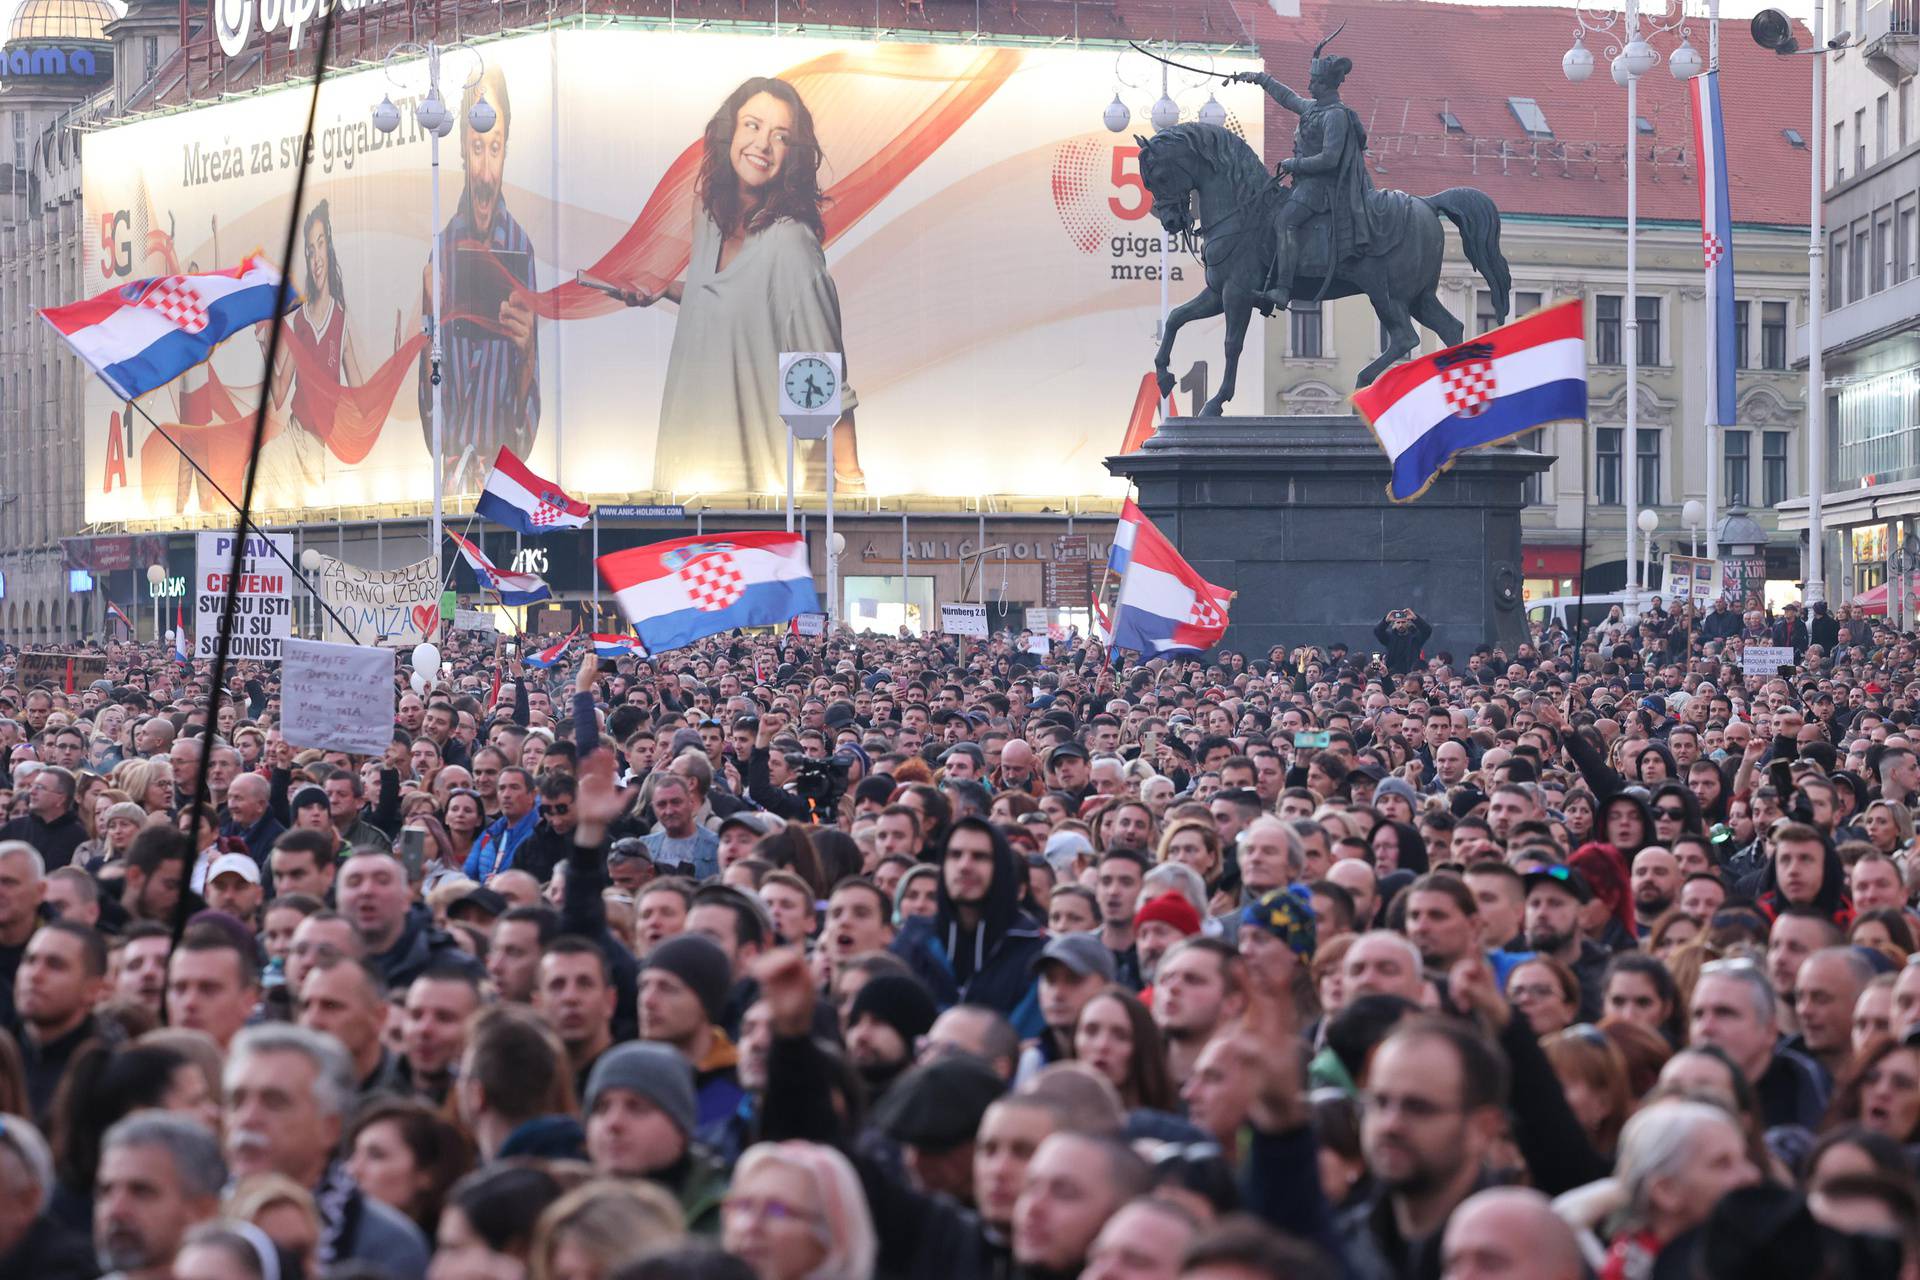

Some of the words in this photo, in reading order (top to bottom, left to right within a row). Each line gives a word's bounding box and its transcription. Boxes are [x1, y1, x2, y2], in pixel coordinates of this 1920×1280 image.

[183, 135, 244, 187] Mreža
[251, 139, 273, 174] za
[101, 210, 132, 279] 5G
[1111, 260, 1184, 281] mrea
[103, 399, 133, 494] A1
[240, 559, 255, 574] LI
[324, 558, 345, 578] ZA
[336, 581, 384, 604] PRAVO
[260, 598, 289, 615] ISTI
[942, 607, 974, 617] Nürnberg
[250, 617, 271, 635] SU
[330, 604, 416, 636] KOMIŽA
